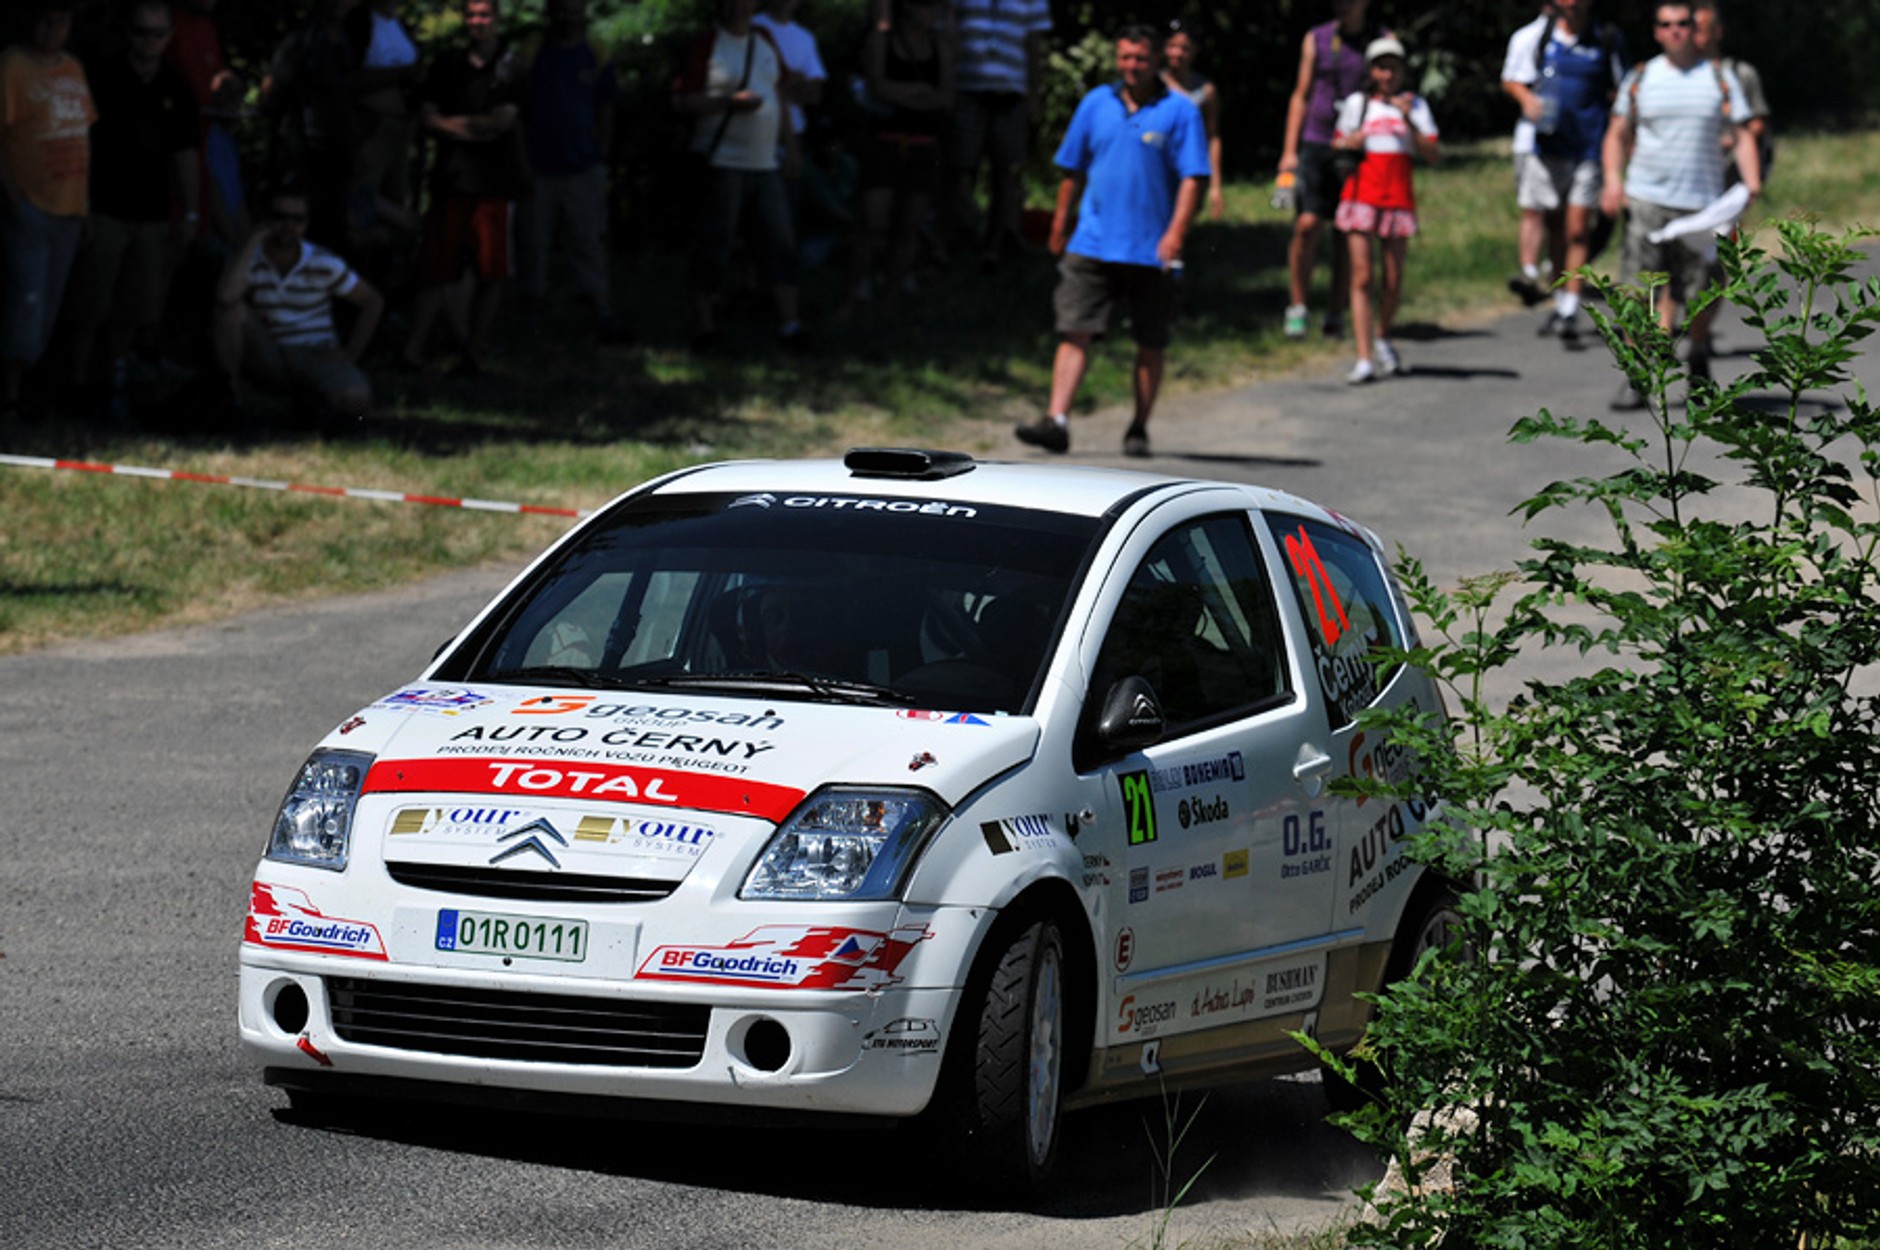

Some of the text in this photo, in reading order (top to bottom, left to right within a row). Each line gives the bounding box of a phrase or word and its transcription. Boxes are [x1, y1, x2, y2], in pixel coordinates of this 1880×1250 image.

[784, 496, 978, 518] CITROËN
[1284, 524, 1350, 647] 21
[585, 703, 785, 731] geosan
[449, 725, 775, 760] AUTO ČERNÝ
[488, 762, 680, 802] TOTAL
[1123, 773, 1156, 844] 21
[1191, 794, 1230, 827] Škoda
[633, 838, 701, 857] SYSTEM
[1350, 804, 1406, 889] AUTO
[266, 918, 371, 945] BFGoodrich
[661, 950, 798, 976] BFGoodrich
[1135, 1001, 1176, 1032] geosan
